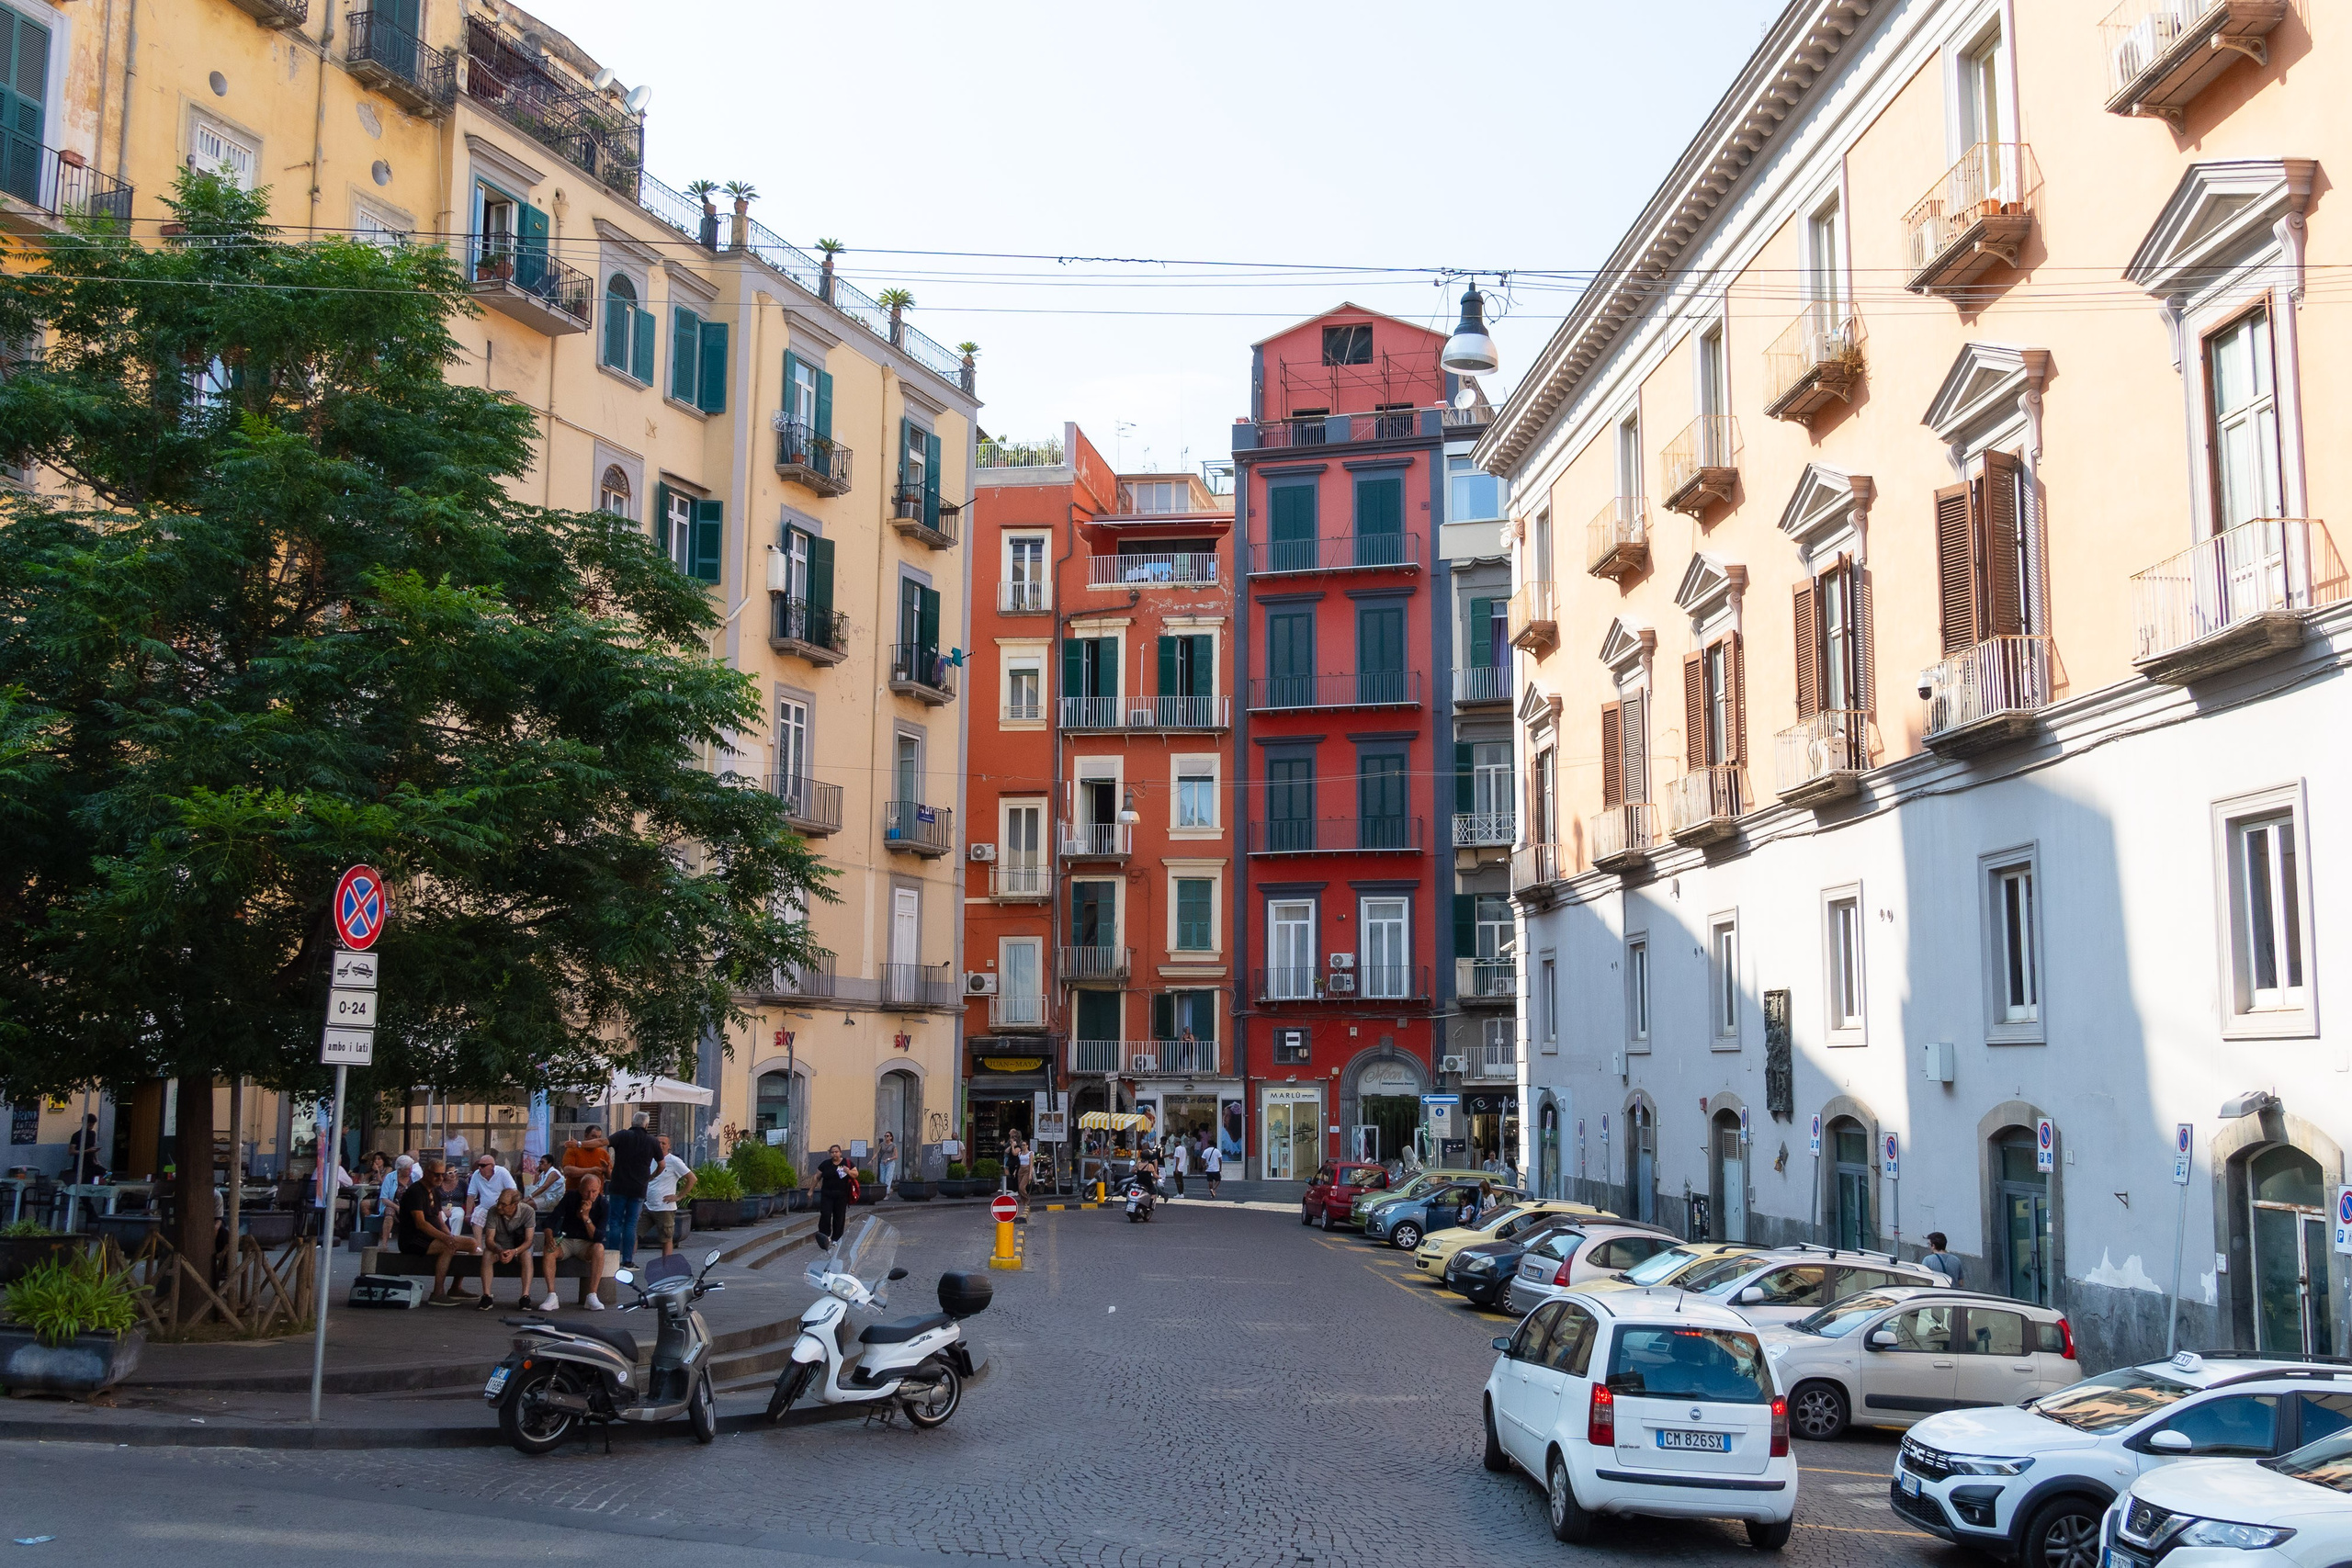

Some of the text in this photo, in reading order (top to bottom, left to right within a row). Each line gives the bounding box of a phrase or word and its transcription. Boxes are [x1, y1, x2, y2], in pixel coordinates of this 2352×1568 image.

[339, 1000, 367, 1015] 0-24
[774, 1027, 796, 1050] sky
[893, 1030, 911, 1052] sky
[327, 1041, 369, 1053] ambo i lati
[2173, 1354, 2193, 1365] TAXI
[1666, 1432, 1723, 1449] CM 826SX
